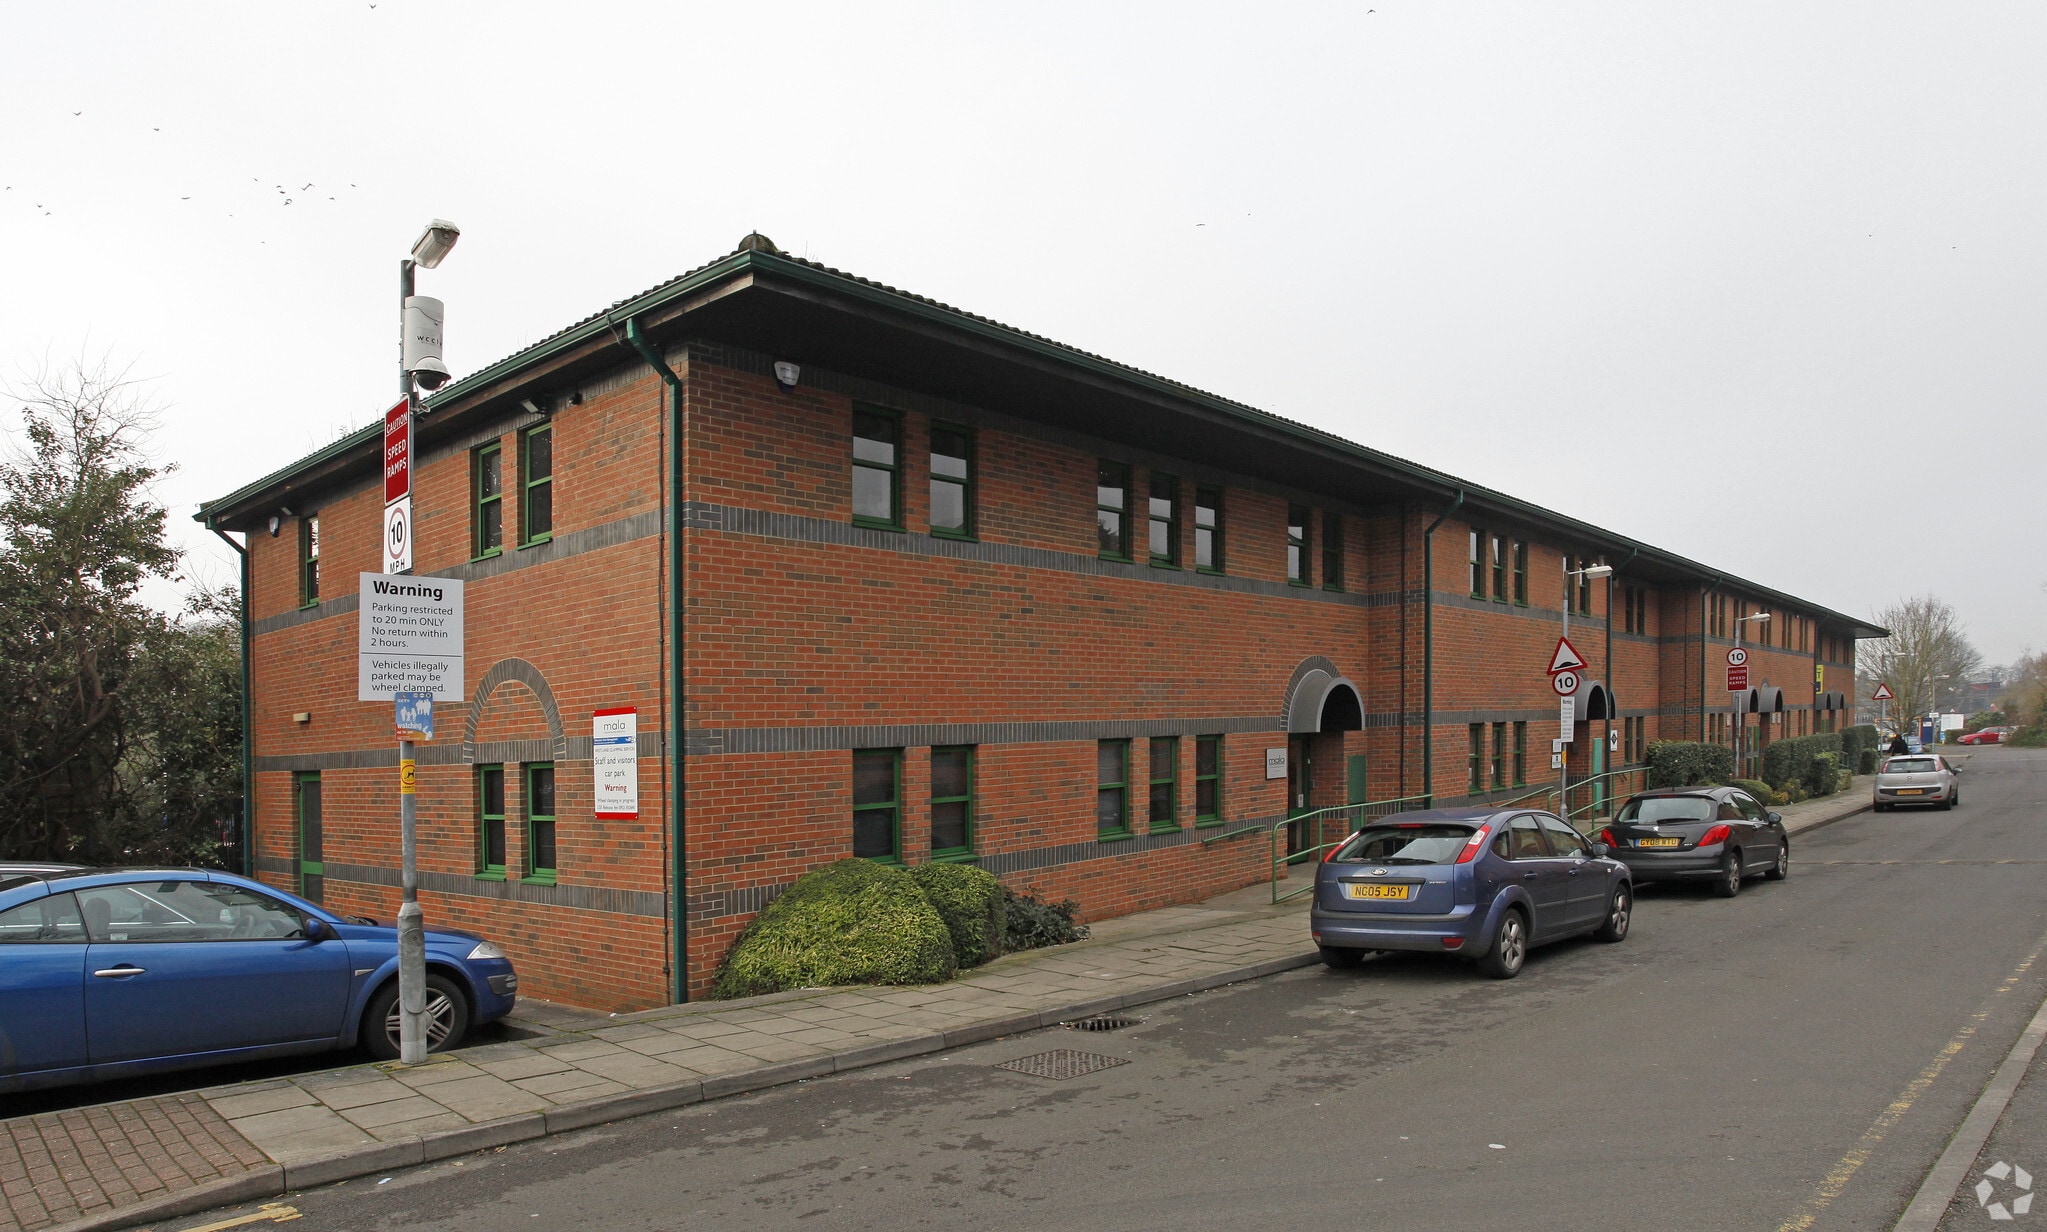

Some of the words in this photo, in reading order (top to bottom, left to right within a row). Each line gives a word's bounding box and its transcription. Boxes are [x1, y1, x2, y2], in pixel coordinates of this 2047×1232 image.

[387, 412, 408, 434] CAUTION
[388, 439, 406, 460] SPEED
[387, 457, 407, 479] RAMPS
[391, 520, 403, 545] 10
[390, 558, 406, 574] MPH
[373, 580, 443, 601] Warning
[372, 602, 408, 614] Parking
[410, 606, 453, 616] restricted
[385, 616, 397, 624] 20
[400, 616, 417, 625] min
[419, 618, 444, 626] ONLY
[372, 626, 386, 636] No
[388, 628, 417, 636] return
[420, 630, 448, 638] within
[371, 638, 376, 646] 2
[380, 638, 408, 648] hours.
[1731, 652, 1744, 661] 10
[372, 660, 411, 670] Vehicles
[413, 661, 448, 672] illegally
[372, 672, 404, 682] parked
[408, 674, 427, 682] may
[430, 672, 441, 681] be
[1558, 676, 1574, 689] 10
[372, 682, 400, 692] wheel
[403, 683, 446, 692] clamped.
[397, 722, 422, 730] watching
[604, 719, 626, 730] mala
[595, 757, 606, 765] Staff
[614, 770, 626, 779] park
[604, 784, 627, 794] Warning
[1383, 887, 1404, 897] JSY
